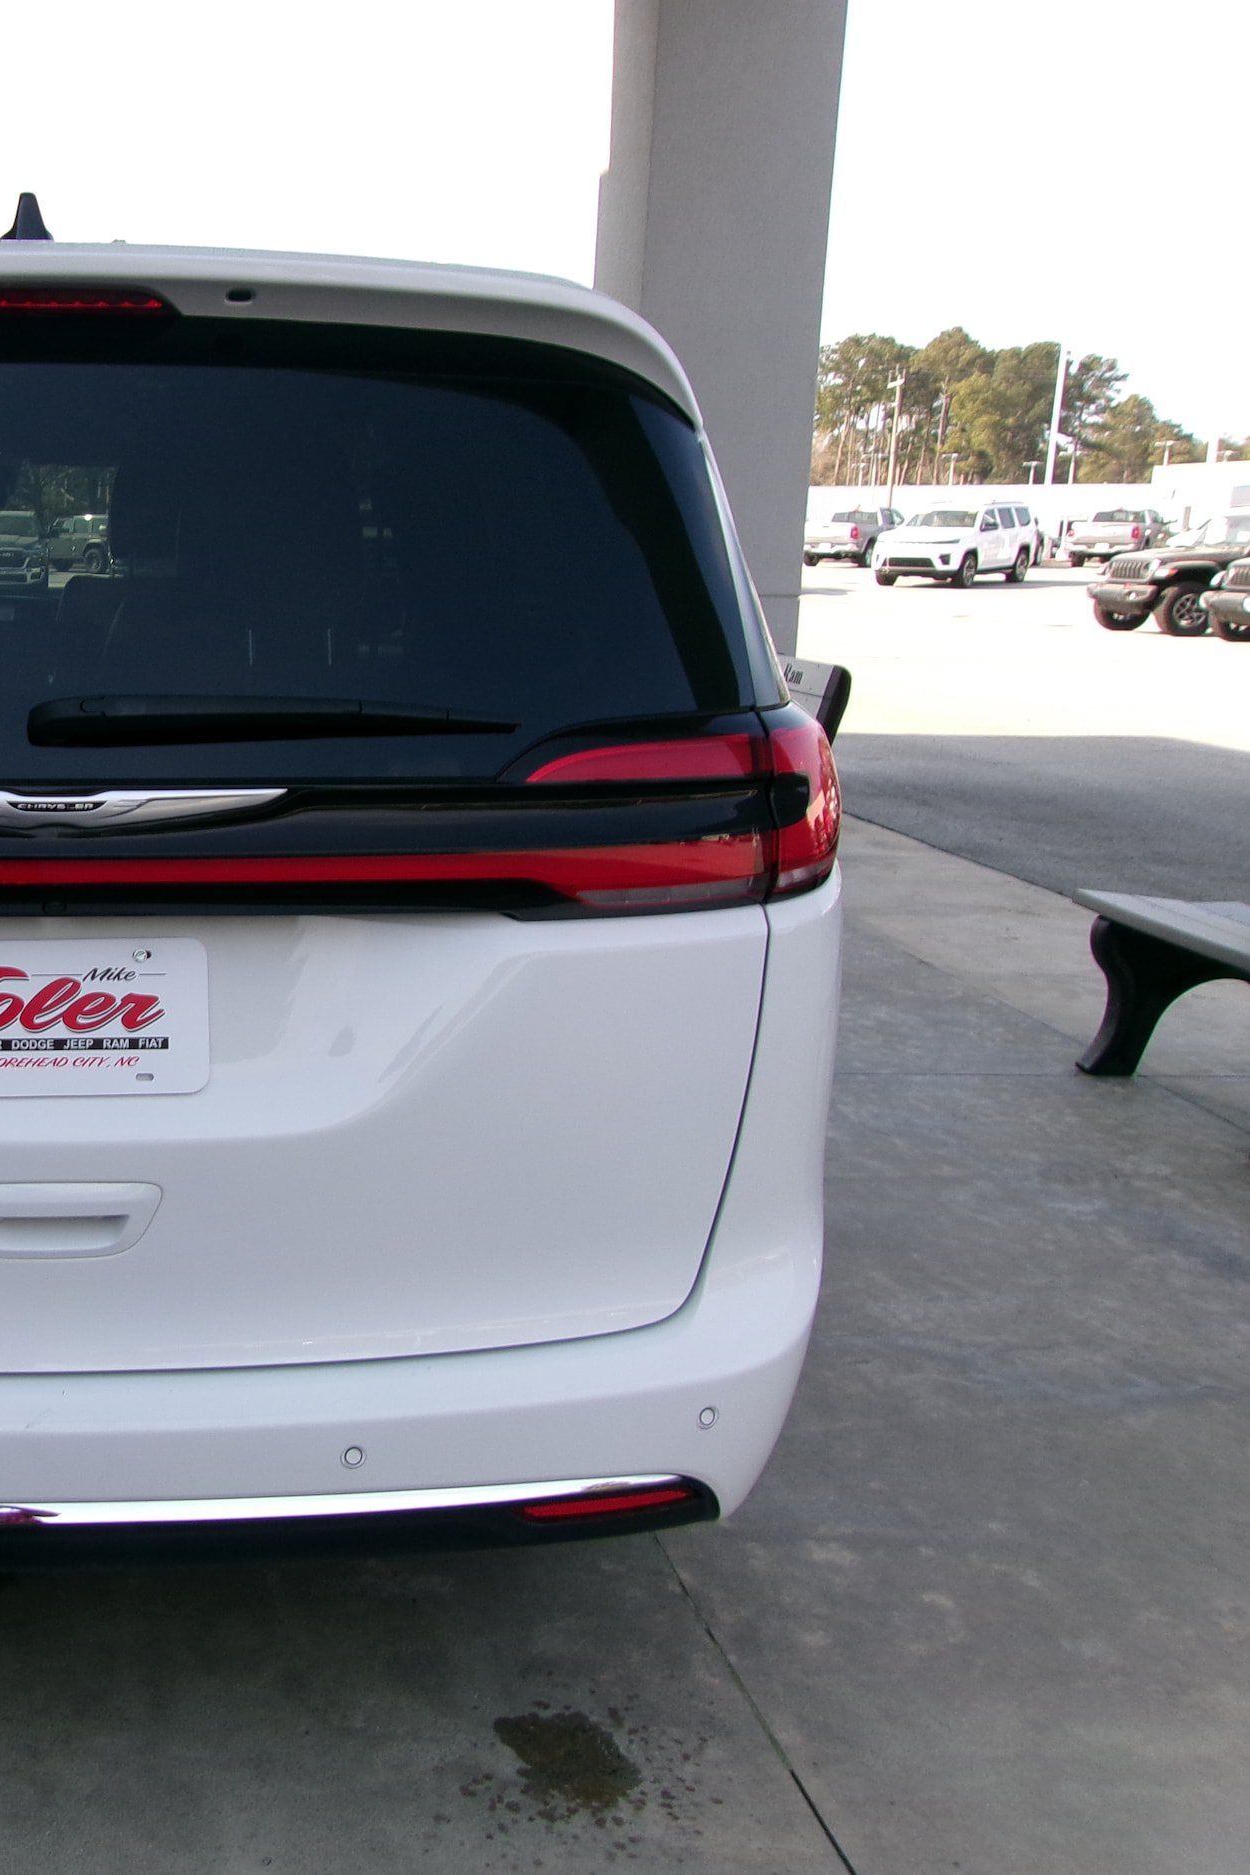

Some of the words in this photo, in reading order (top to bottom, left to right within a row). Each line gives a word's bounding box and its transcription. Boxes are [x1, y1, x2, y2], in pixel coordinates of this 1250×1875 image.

[784, 663, 803, 684] Ram
[83, 967, 136, 982] Mike
[11, 1039, 54, 1050] DODGE
[63, 1038, 93, 1049] JEEP
[103, 1038, 129, 1049] RAM
[138, 1037, 163, 1048] FIAT
[72, 1057, 110, 1068] CITY,
[114, 1056, 139, 1067] NC
